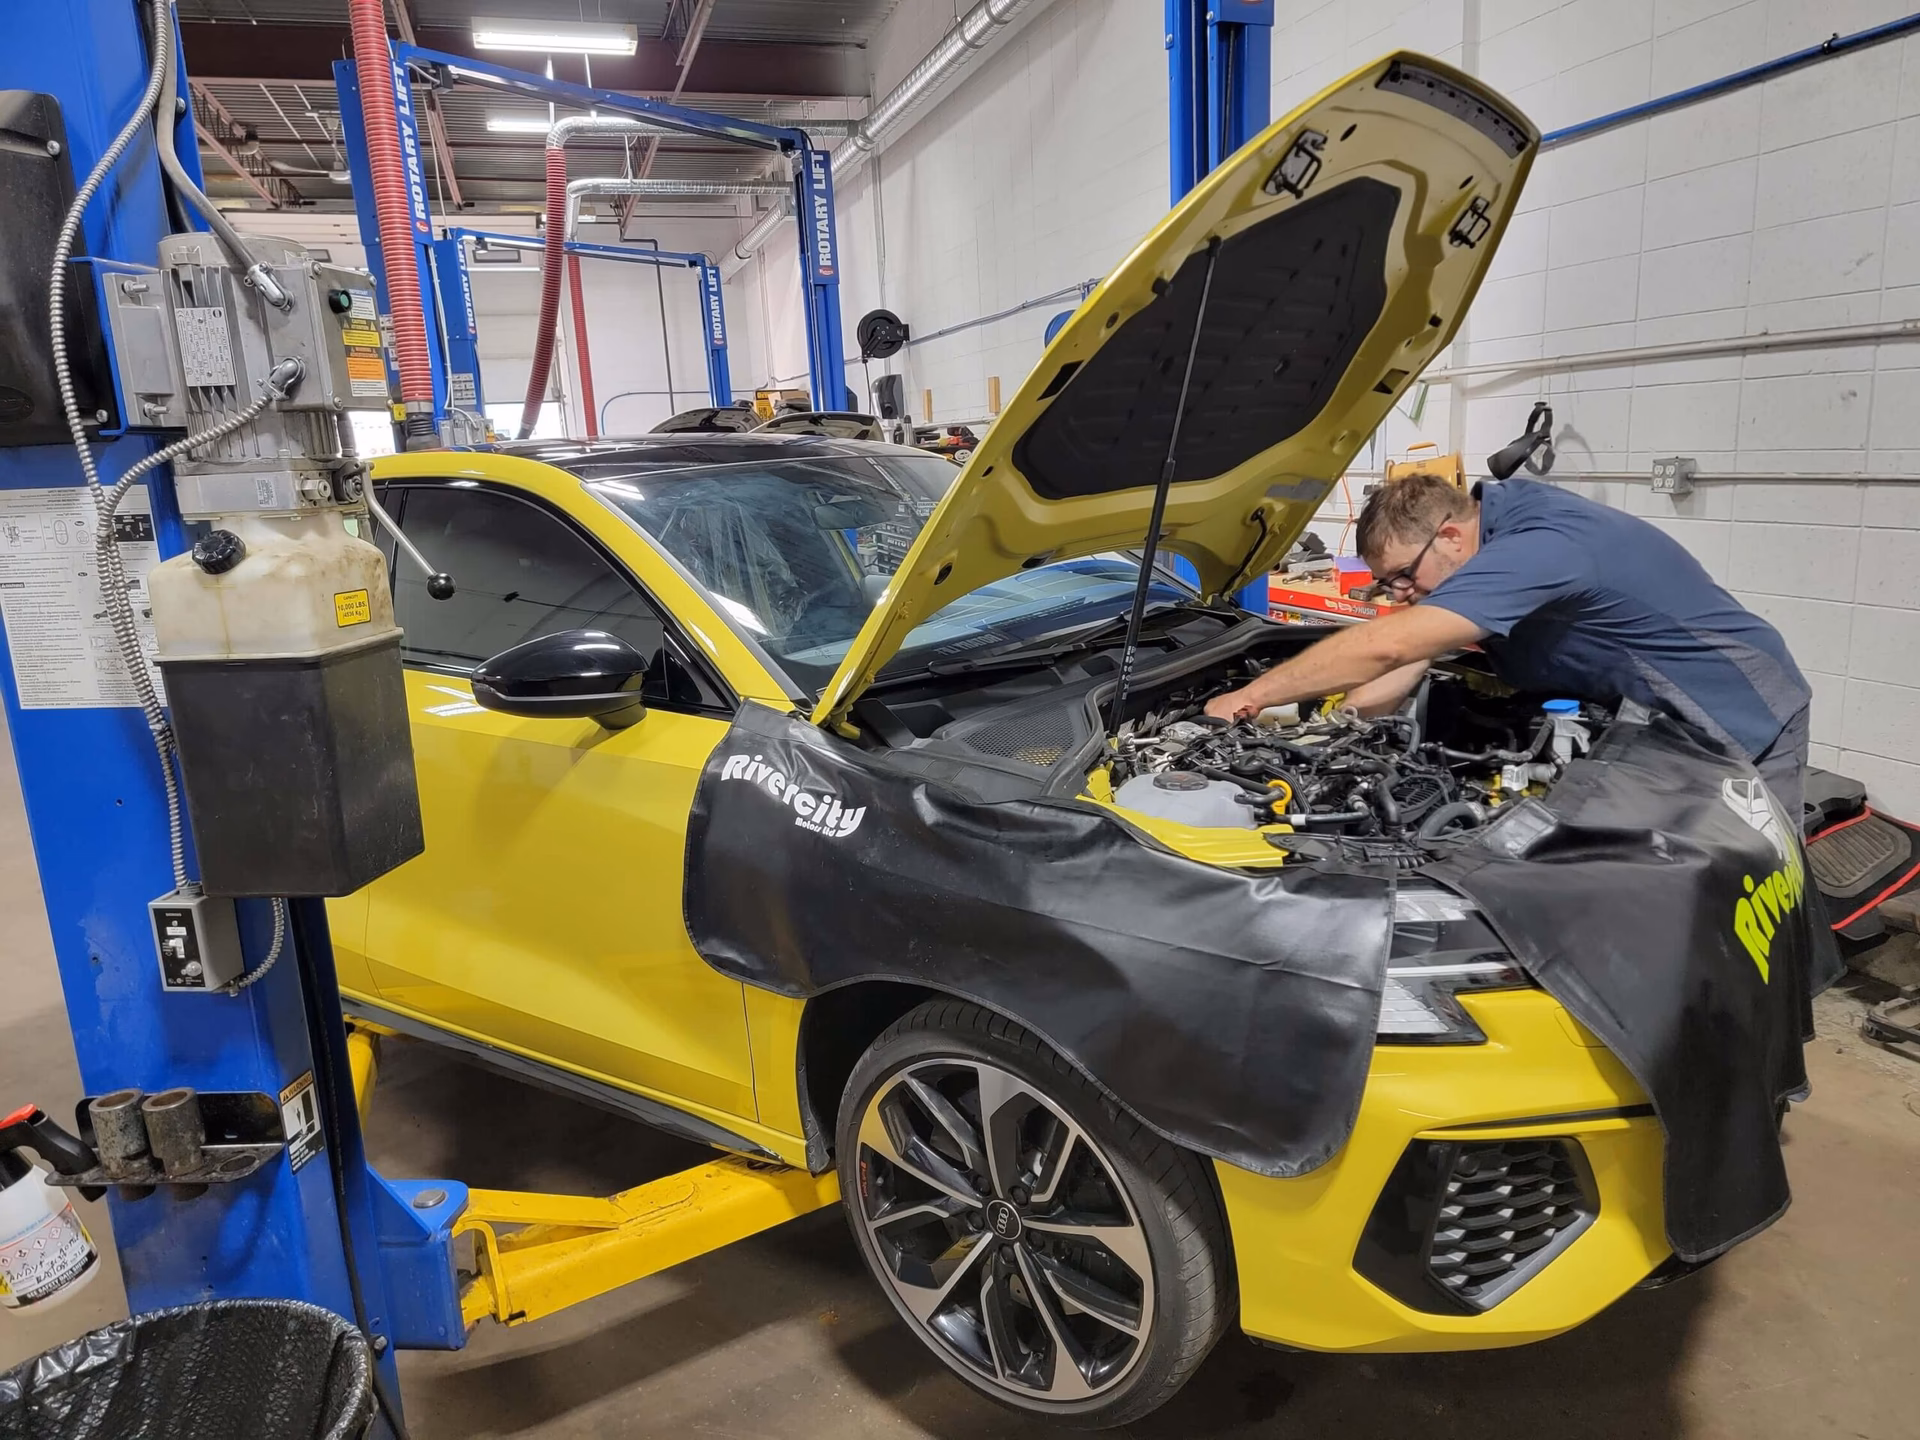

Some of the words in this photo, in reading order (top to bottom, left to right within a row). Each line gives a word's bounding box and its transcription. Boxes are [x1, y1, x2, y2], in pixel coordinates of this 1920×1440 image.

[393, 61, 411, 116] LIFT
[401, 120, 426, 220] ROTARY
[811, 152, 826, 189] LIFT
[814, 195, 832, 266] ROTARY
[457, 242, 466, 270] LIFT
[707, 268, 718, 291] LIFT
[462, 273, 475, 327] ROTARY
[710, 294, 723, 338] ROTARY
[795, 817, 822, 832] Motors
[822, 826, 836, 837] Ltd
[288, 1073, 312, 1095] WARNING
[26, 1289, 39, 1298] SEE
[38, 1279, 59, 1293] SAFETY
[59, 1269, 74, 1283] DATA
